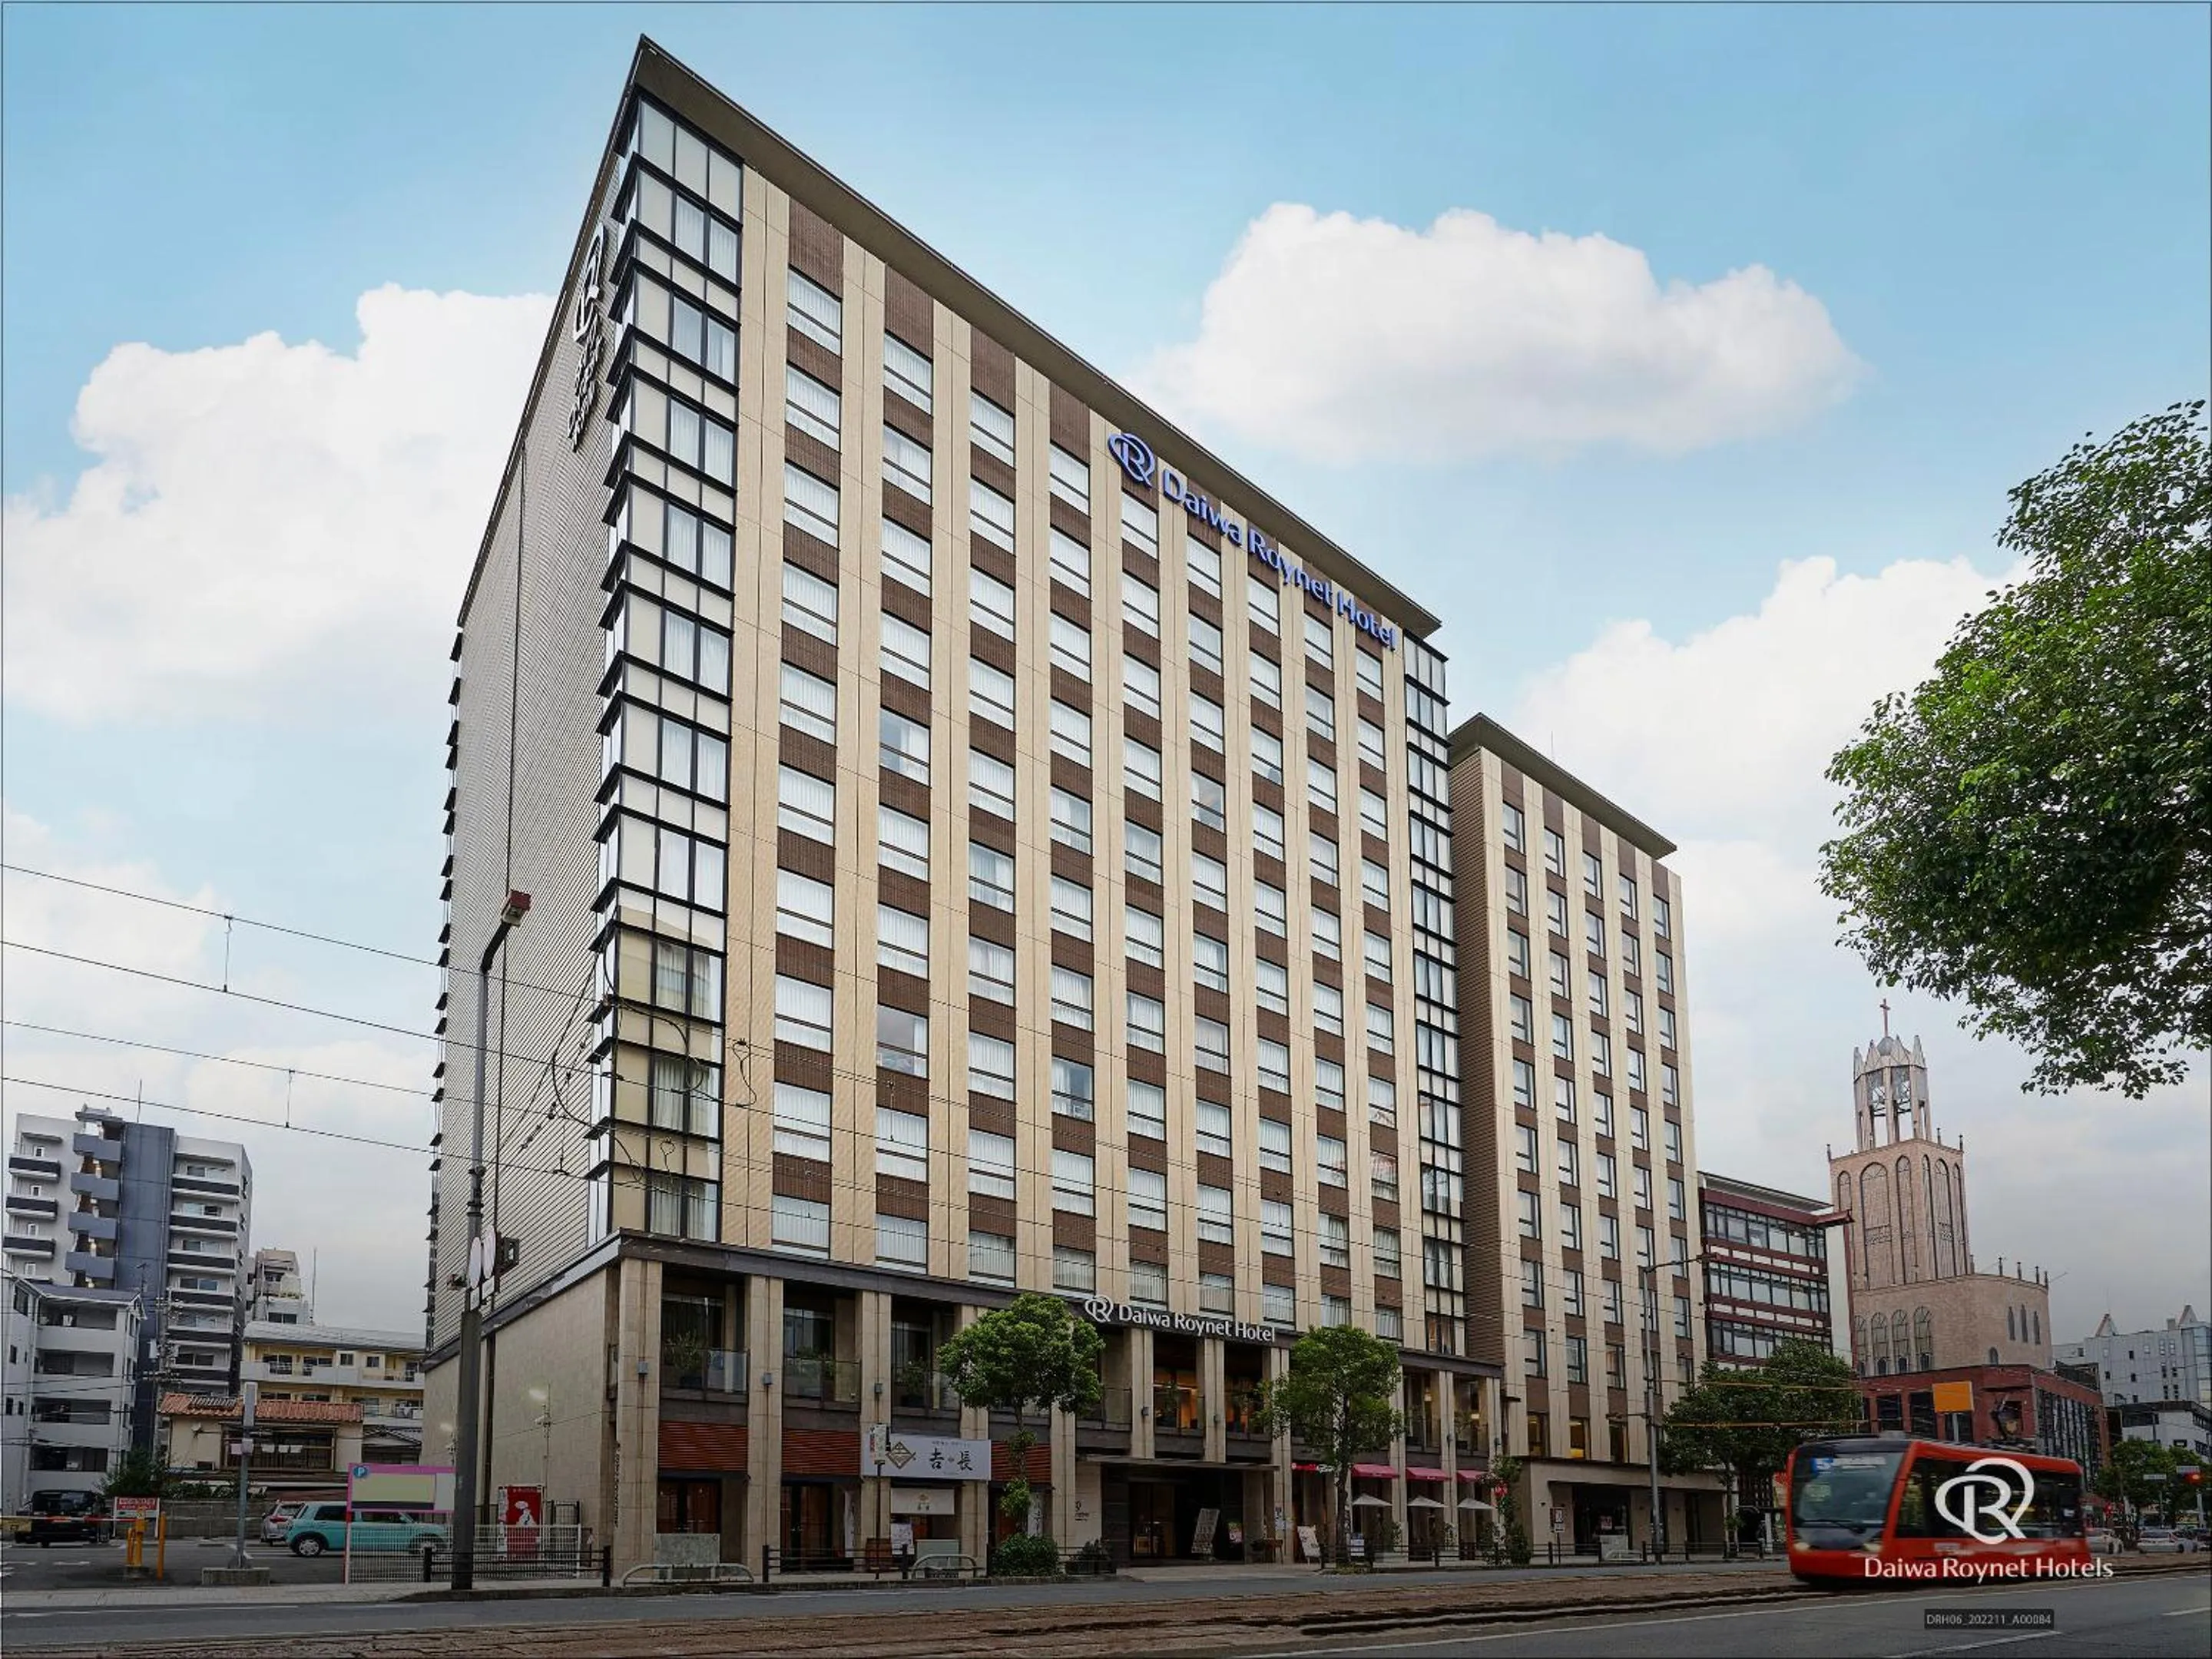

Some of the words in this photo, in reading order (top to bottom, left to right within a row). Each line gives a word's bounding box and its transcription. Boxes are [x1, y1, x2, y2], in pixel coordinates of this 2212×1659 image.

[1163, 469, 1242, 546] Daiwa
[1247, 528, 1333, 609] Roynet
[1337, 590, 1396, 651] Hotel
[1118, 1305, 1170, 1328] Daiwa
[1174, 1313, 1232, 1337] Roynet
[1235, 1320, 1275, 1343] Hotel
